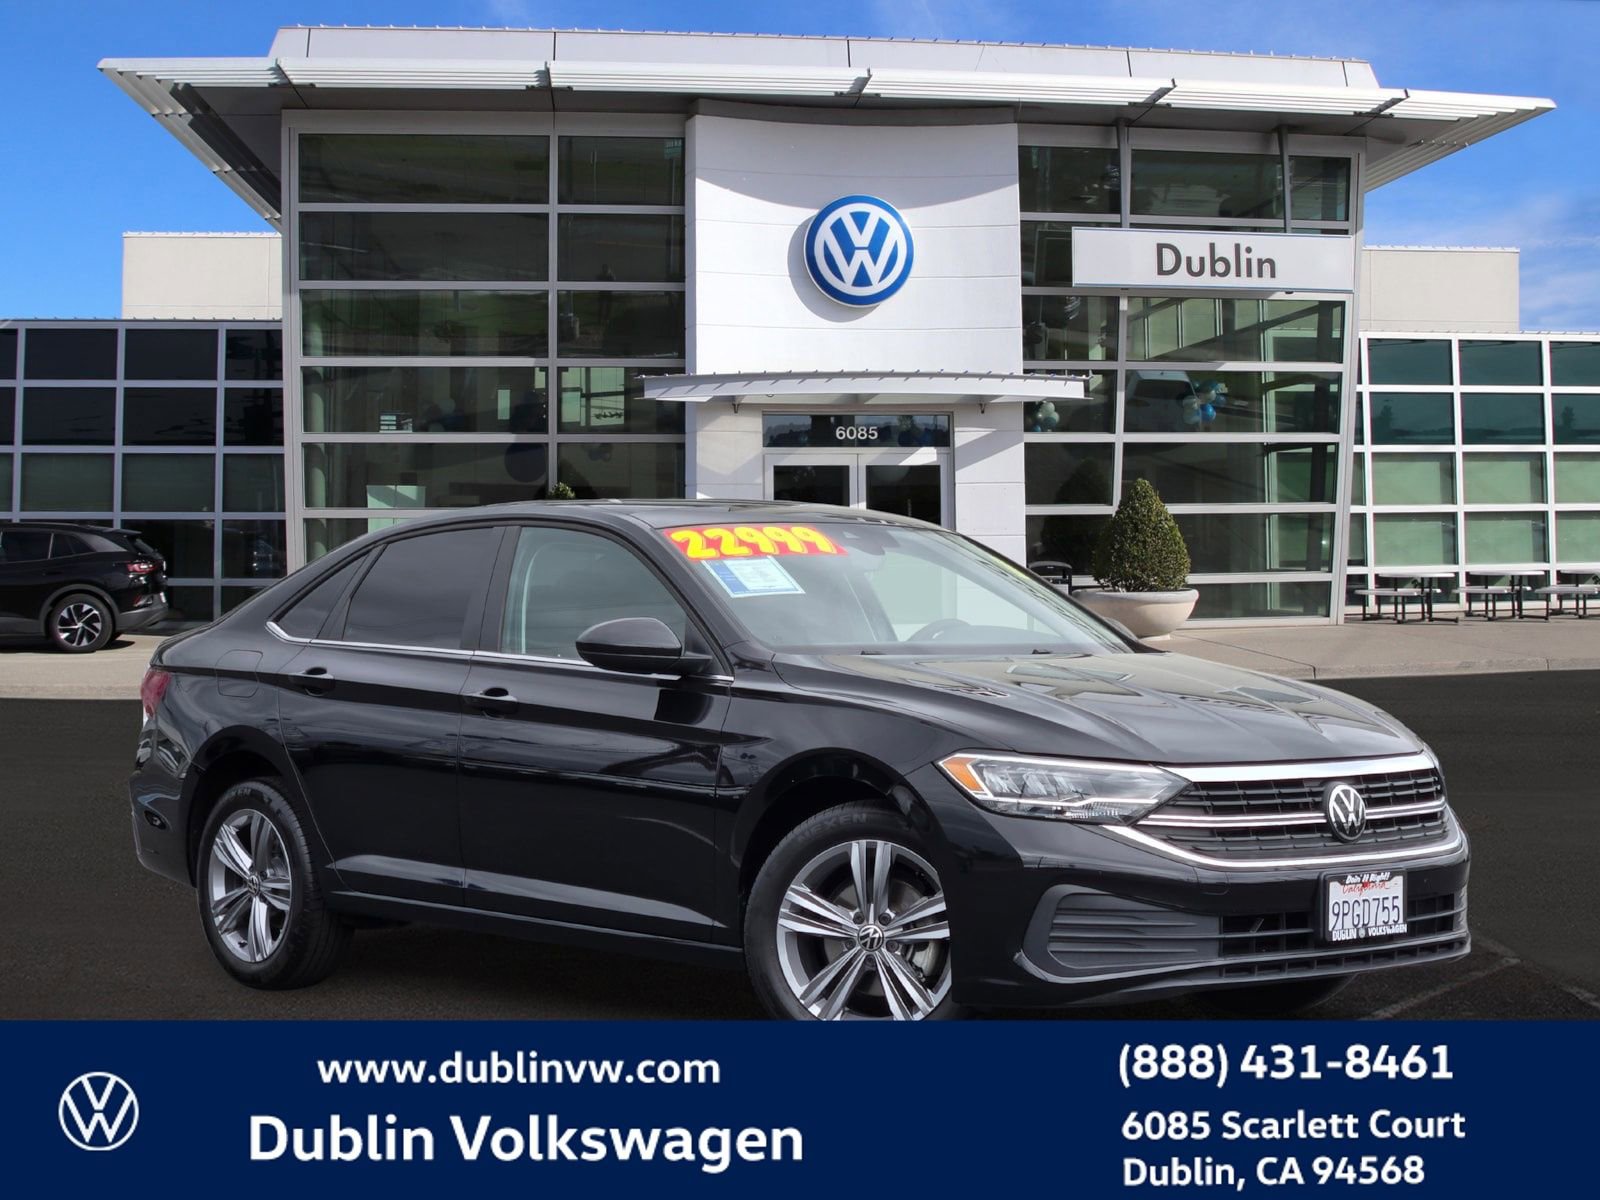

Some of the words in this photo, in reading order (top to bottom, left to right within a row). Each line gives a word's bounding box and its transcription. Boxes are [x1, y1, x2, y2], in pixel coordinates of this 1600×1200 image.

[804, 194, 915, 307] VW
[1156, 242, 1277, 279] Dublin
[835, 426, 879, 440] 6085
[670, 526, 838, 559] 22999
[797, 812, 868, 842] NEXEN
[1332, 895, 1401, 931] 9PGD755
[1332, 927, 1358, 942] DUBLIN
[1367, 923, 1408, 937] VOLKSWAGEN
